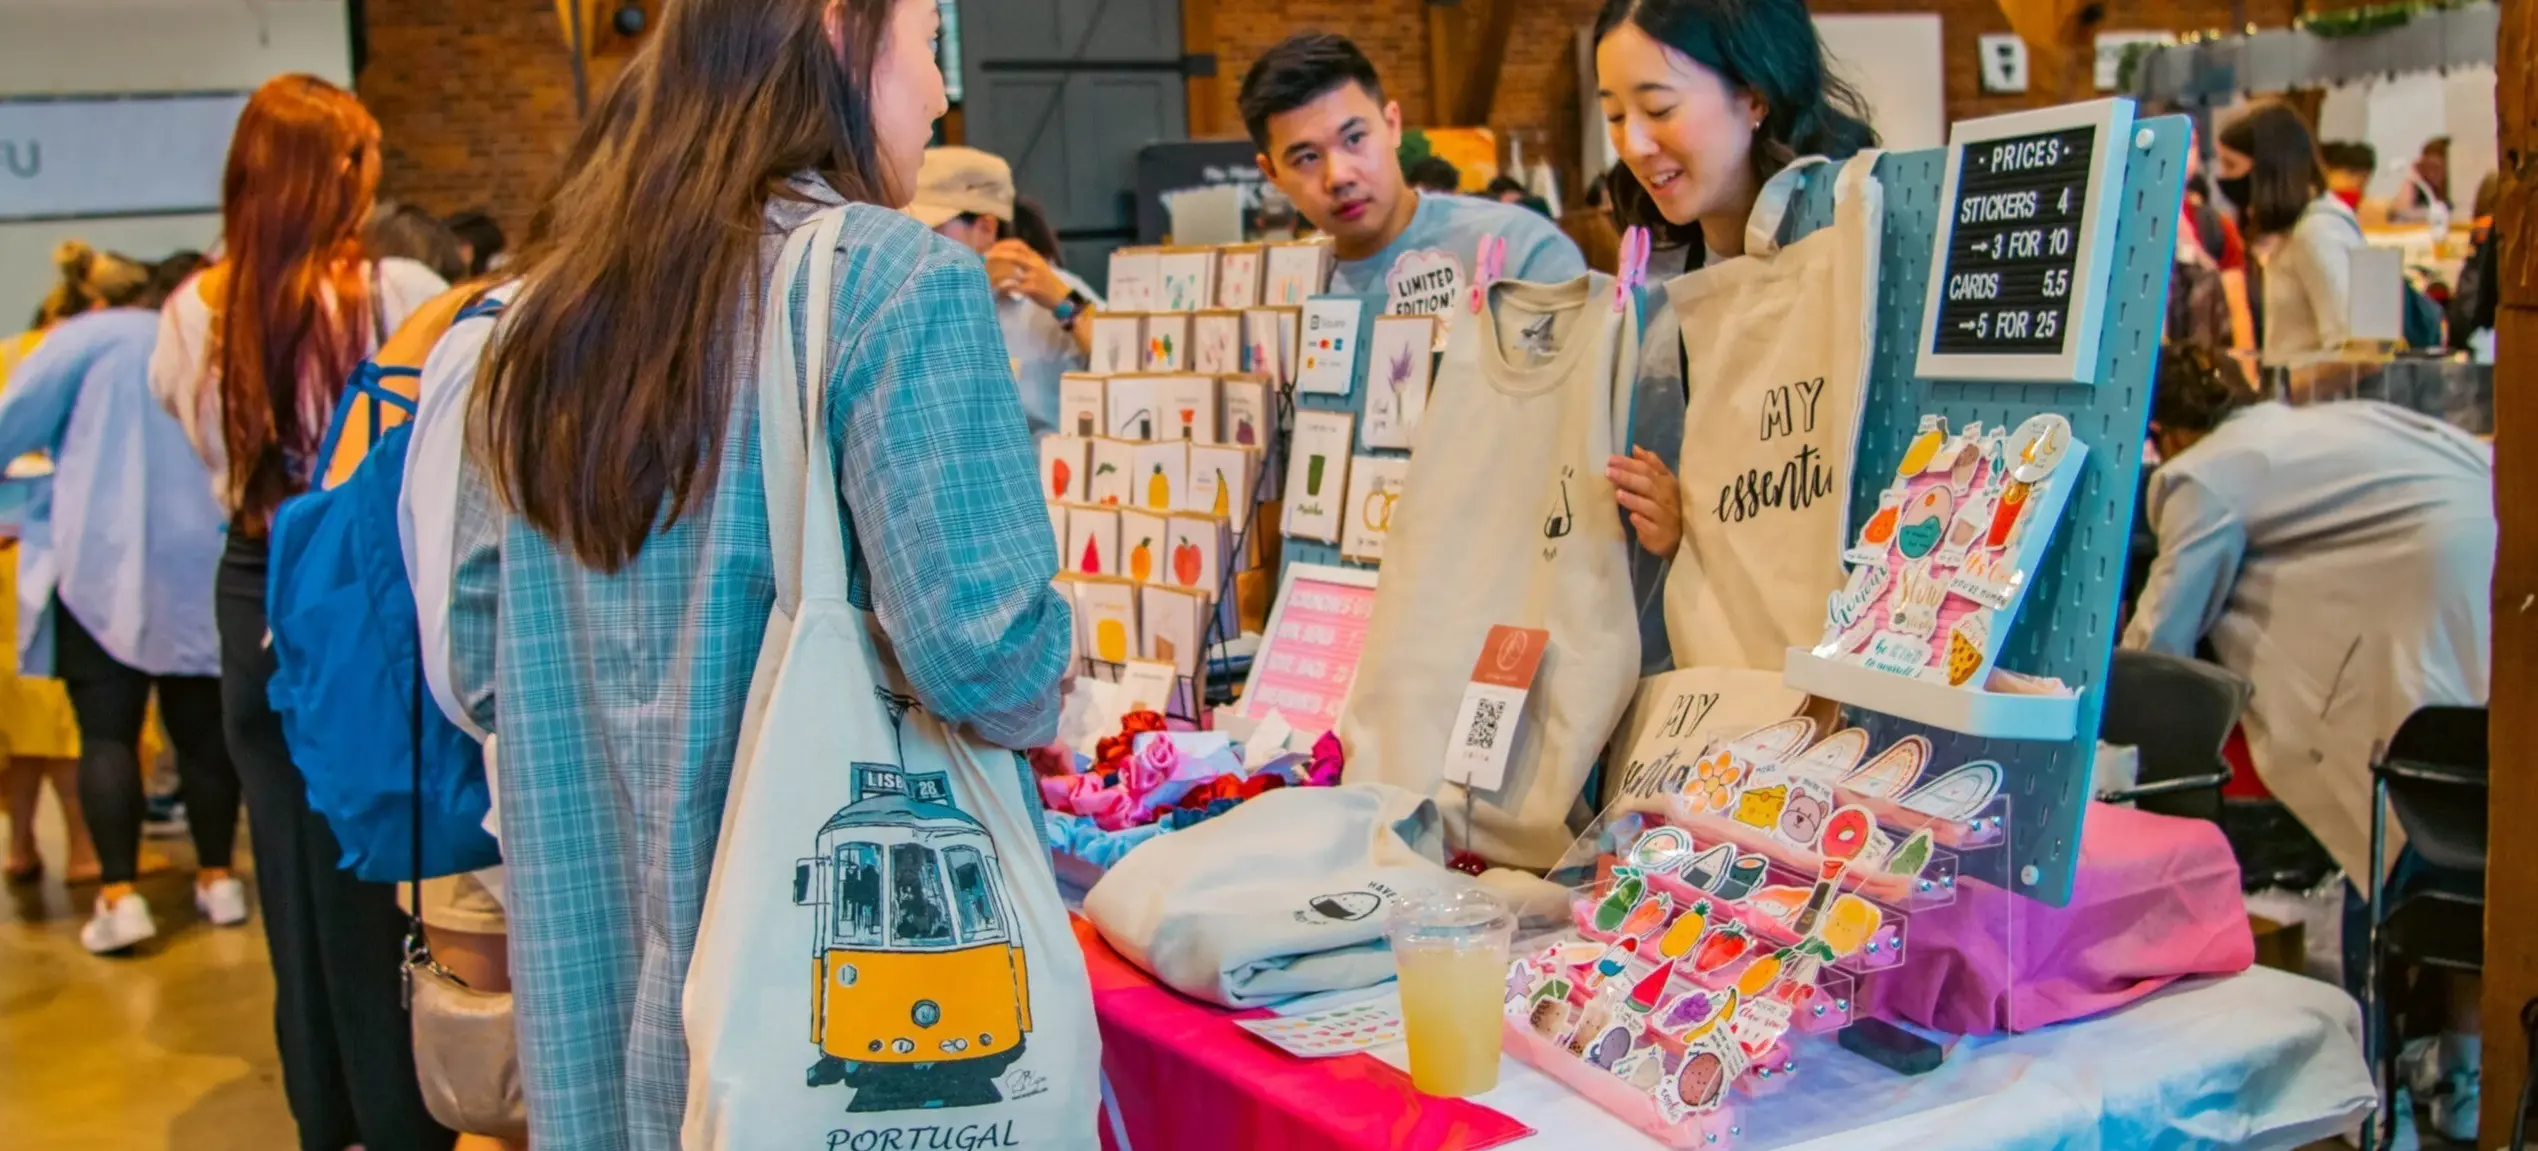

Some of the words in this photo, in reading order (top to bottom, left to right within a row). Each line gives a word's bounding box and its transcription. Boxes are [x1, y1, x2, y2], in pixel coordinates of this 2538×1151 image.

[1990, 139, 2059, 173] PRICES
[1960, 191, 2037, 224] STICKERS
[2057, 187, 2069, 215] 4
[1991, 234, 2003, 260] 3
[2008, 229, 2041, 258] FOR
[2048, 228, 2069, 255] 10
[1397, 267, 1455, 298] LIMITED
[1949, 273, 1999, 300] CARDS
[1396, 288, 1456, 315] EDITION!
[1976, 313, 1988, 338] 5
[1995, 311, 2027, 338] FOR
[2034, 311, 2058, 338] 25
[1760, 377, 1825, 441] MY
[1655, 693, 1720, 739] MY
[919, 781, 938, 797] 28
[1367, 881, 1398, 899] HAVE
[826, 1119, 1020, 1151] PORTUGAL
